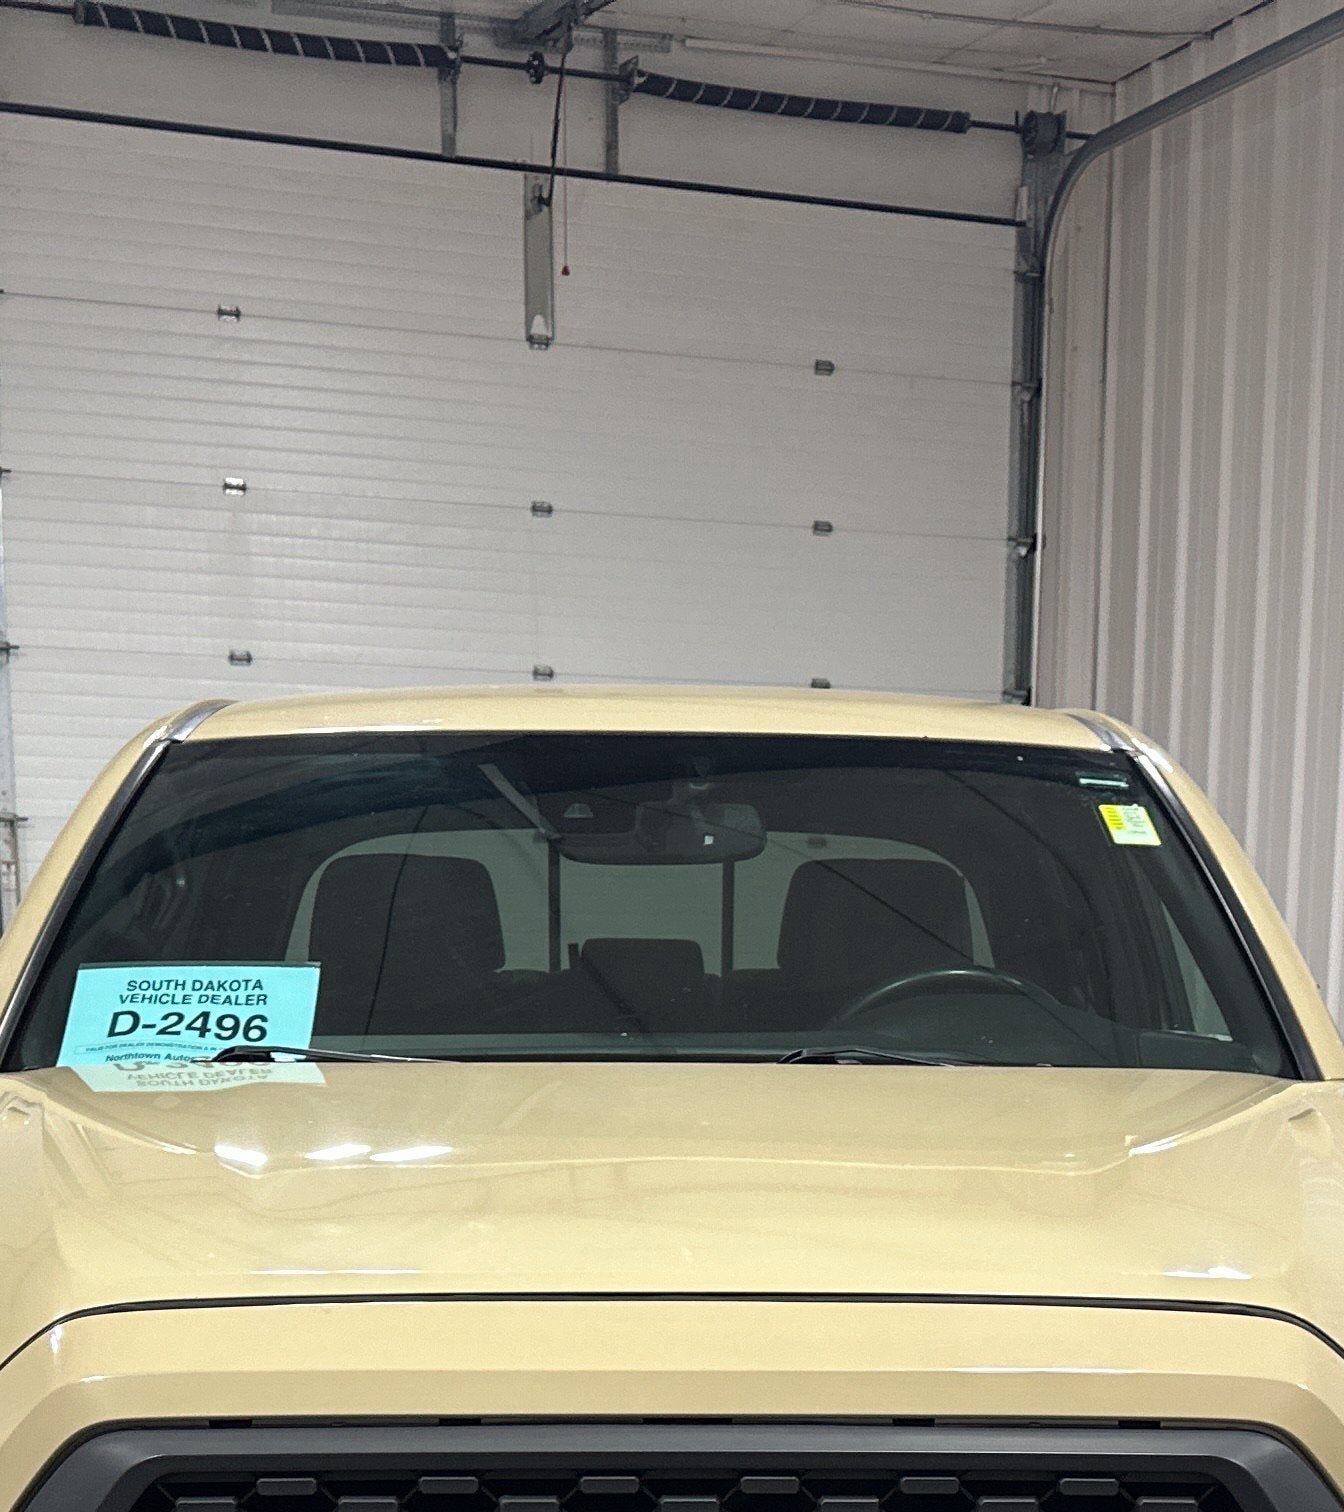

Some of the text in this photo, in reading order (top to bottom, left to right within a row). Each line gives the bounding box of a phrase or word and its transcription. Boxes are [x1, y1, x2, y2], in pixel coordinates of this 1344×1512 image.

[126, 978, 264, 992] SOUTH DAKOTA
[119, 993, 268, 1007] VEHICLE DEALER
[107, 1009, 269, 1043] D-2496
[105, 1052, 161, 1063] Northtown
